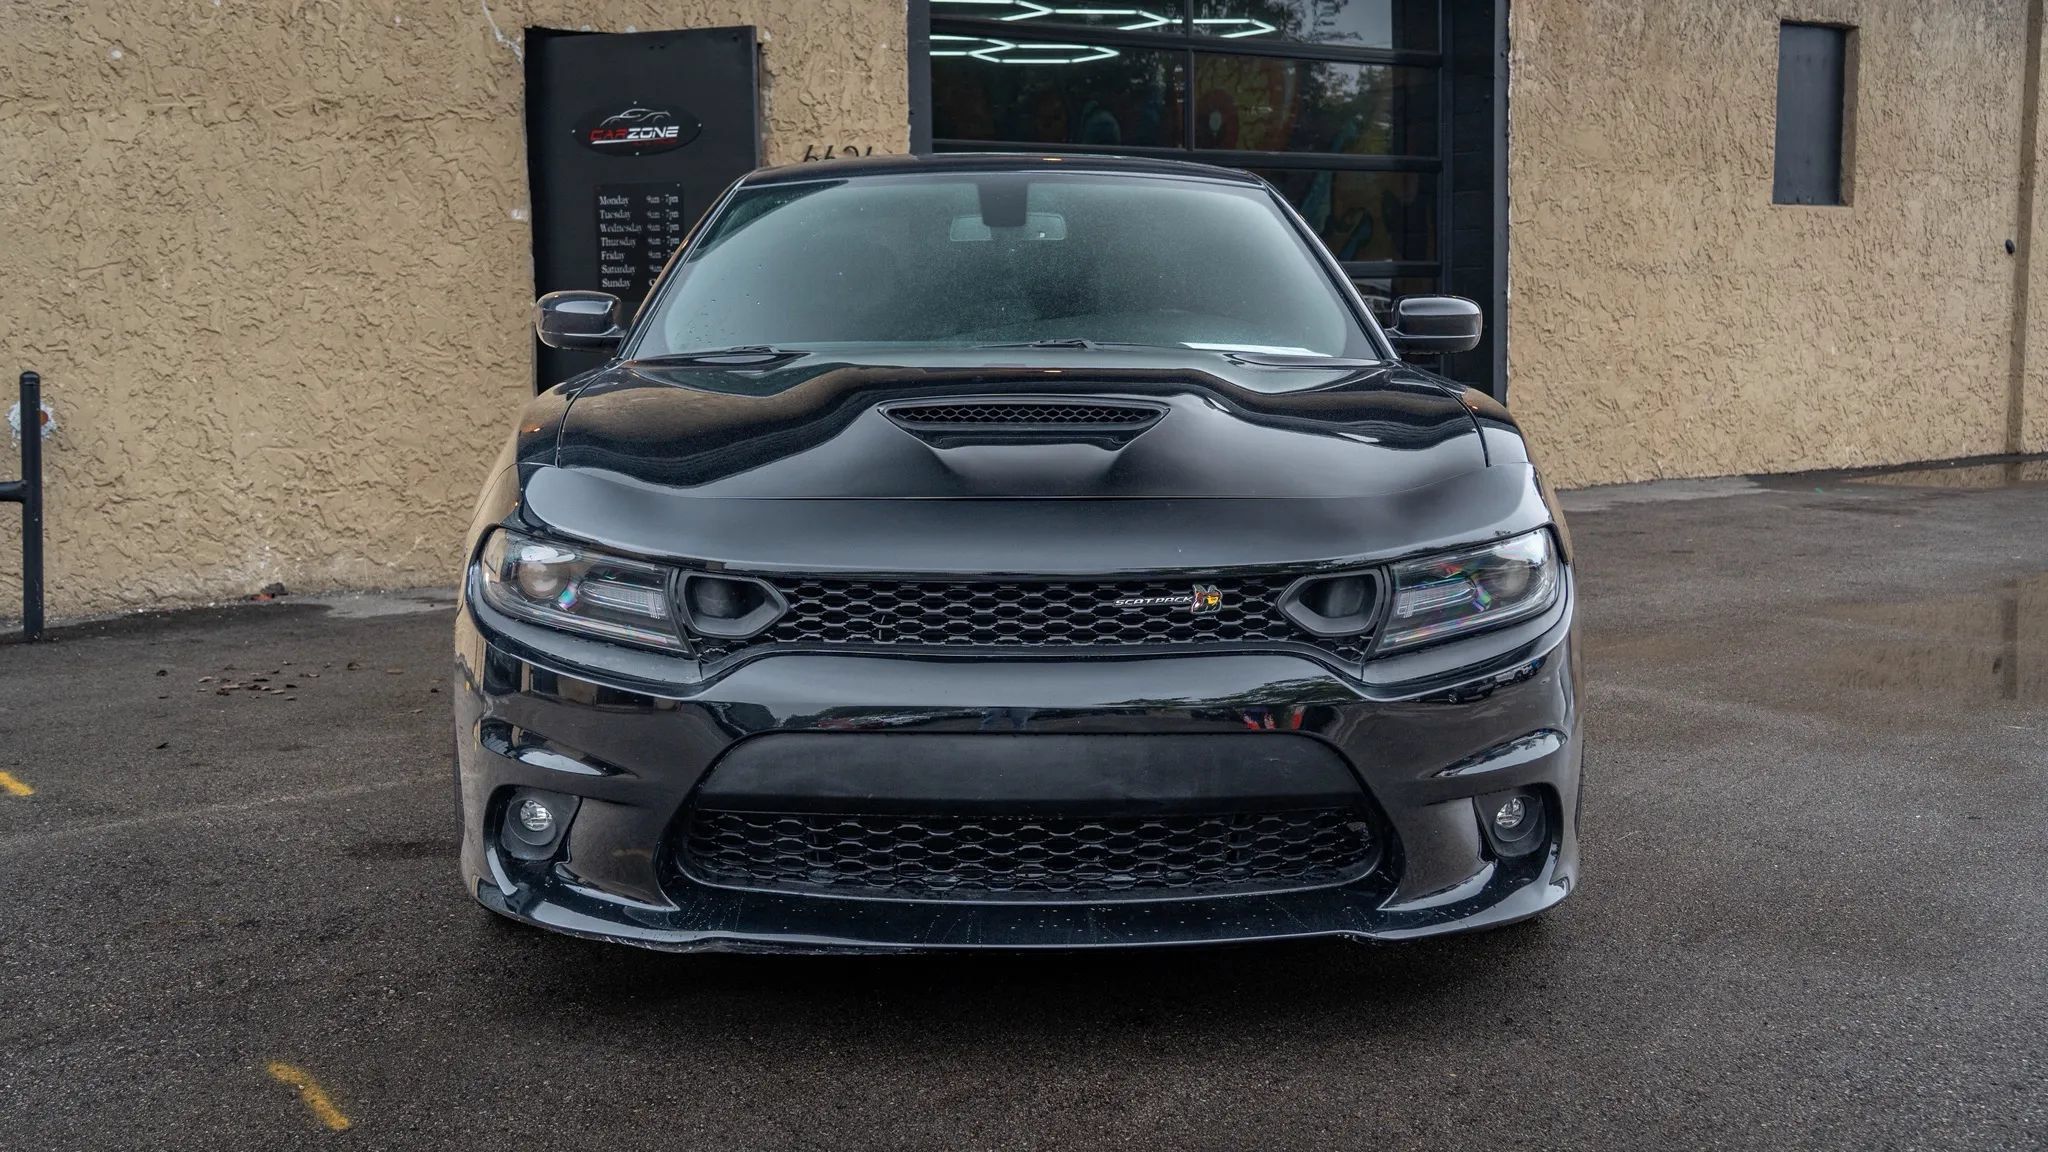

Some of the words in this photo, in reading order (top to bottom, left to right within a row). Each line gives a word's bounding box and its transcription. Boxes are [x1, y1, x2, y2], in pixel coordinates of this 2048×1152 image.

[599, 195, 629, 207] Monday
[664, 194, 679, 205] 7pm
[600, 209, 631, 220] Tuesday
[665, 209, 679, 220] 7pm
[600, 222, 642, 234] Wednesday
[666, 222, 680, 233] 7pm
[601, 237, 636, 248] Thursday
[666, 236, 680, 246] 7pm
[601, 251, 625, 262] Friday
[601, 264, 636, 276] Saturday
[602, 278, 631, 289] Sunday
